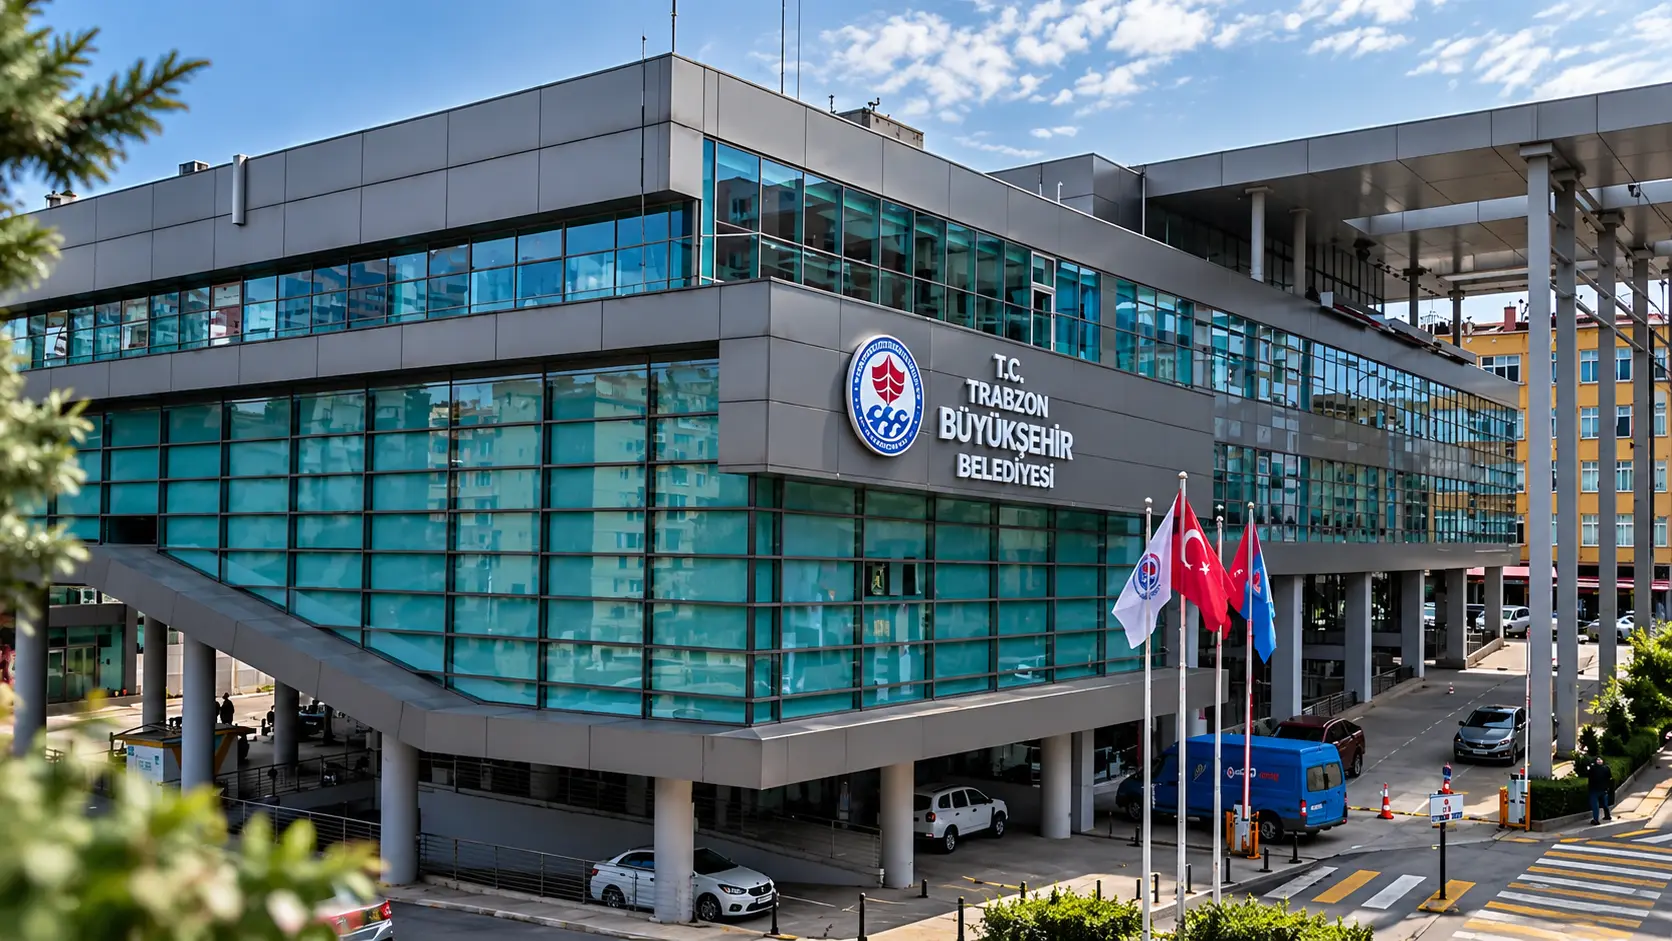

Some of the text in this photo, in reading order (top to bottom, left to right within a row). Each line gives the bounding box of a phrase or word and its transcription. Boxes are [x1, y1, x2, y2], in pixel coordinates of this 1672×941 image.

[993, 353, 1024, 383] T.C.
[966, 378, 1049, 418] TRABZON
[938, 405, 1074, 461] BÜYÜKŞEHİR
[957, 453, 1054, 489] BELEDİYESİ
